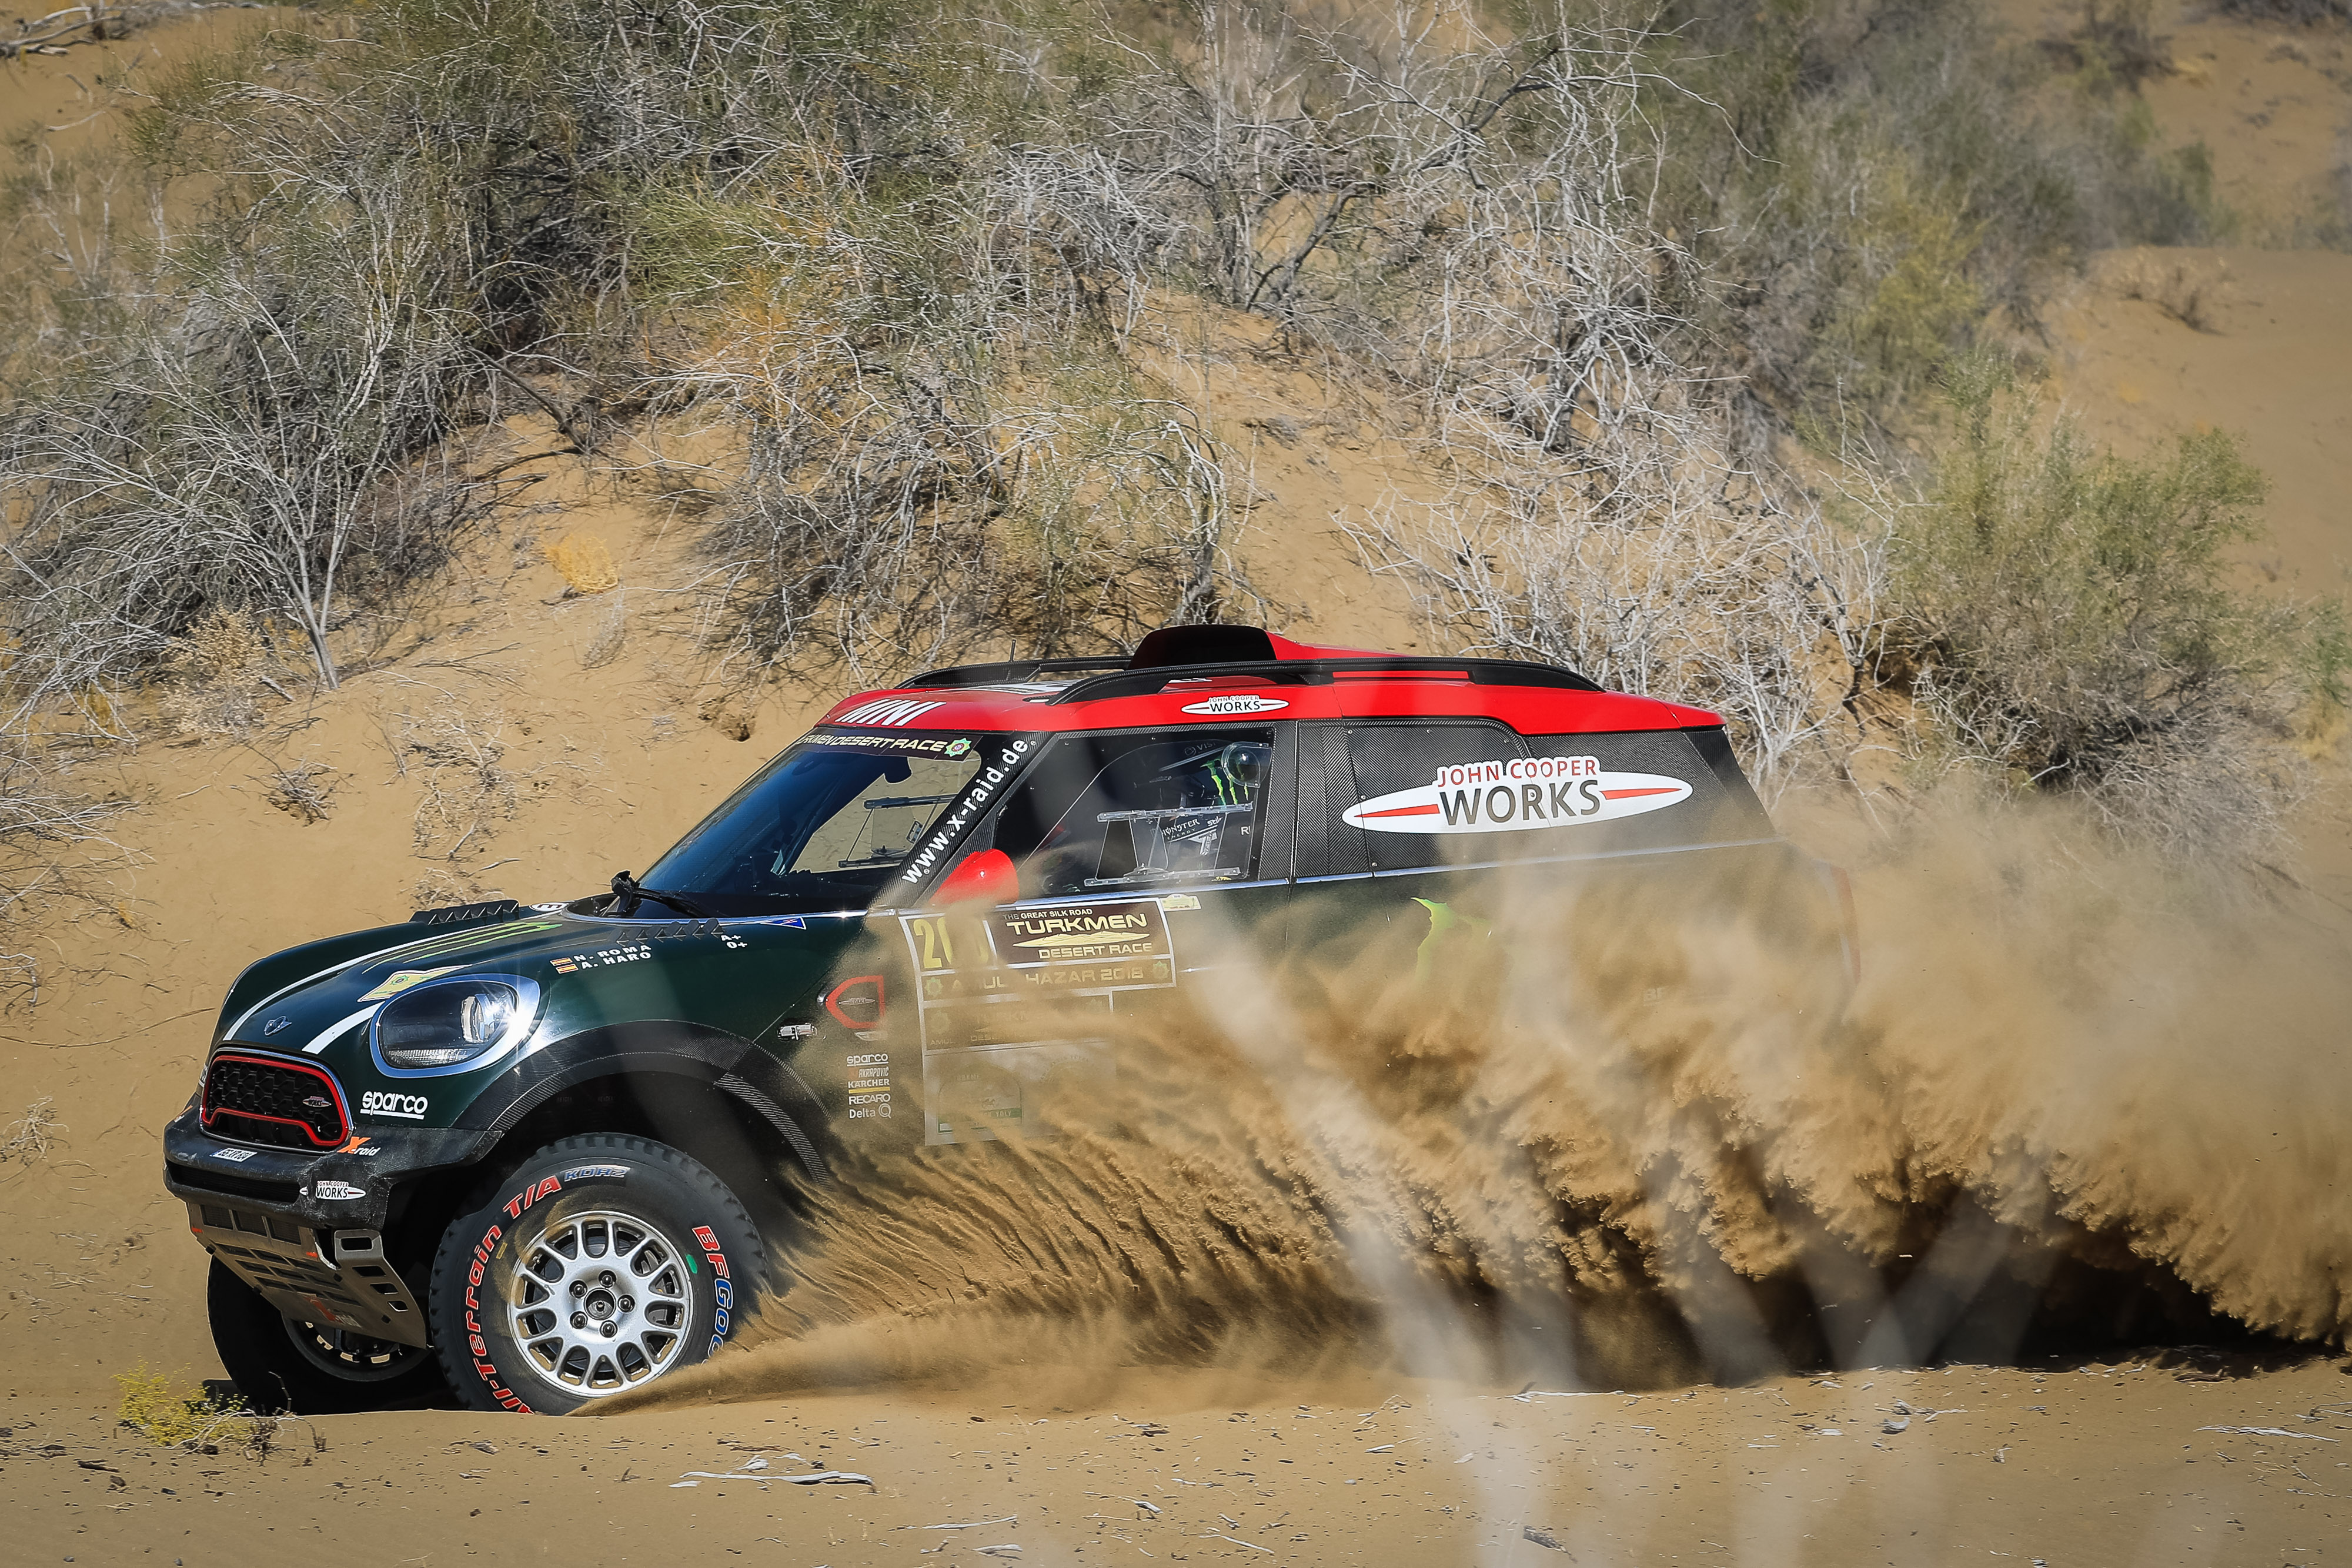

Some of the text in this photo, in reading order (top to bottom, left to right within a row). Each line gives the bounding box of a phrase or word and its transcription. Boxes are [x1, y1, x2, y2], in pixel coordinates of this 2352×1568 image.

[1210, 700, 1261, 712] WORKS
[829, 735, 896, 748] DESERT
[891, 738, 948, 752] RACE
[1437, 760, 1596, 788] JOHN COOPER
[1439, 780, 1601, 826] WORKS
[902, 739, 1028, 884] www.x-raid.de
[1020, 911, 1048, 920] GREAT
[1006, 913, 1148, 935] TURKMEN
[720, 934, 741, 942] A+
[597, 944, 652, 958] ROMA
[1038, 942, 1152, 959] DESERT RACE
[581, 951, 652, 970] A. HARO
[1100, 967, 1144, 981] 2018
[847, 1053, 889, 1067] sparco
[360, 1091, 429, 1118] sparco
[848, 1093, 891, 1105] RECARO
[849, 1108, 876, 1119] Delta
[316, 1187, 348, 1198] WORKS
[503, 1175, 562, 1220] T/A
